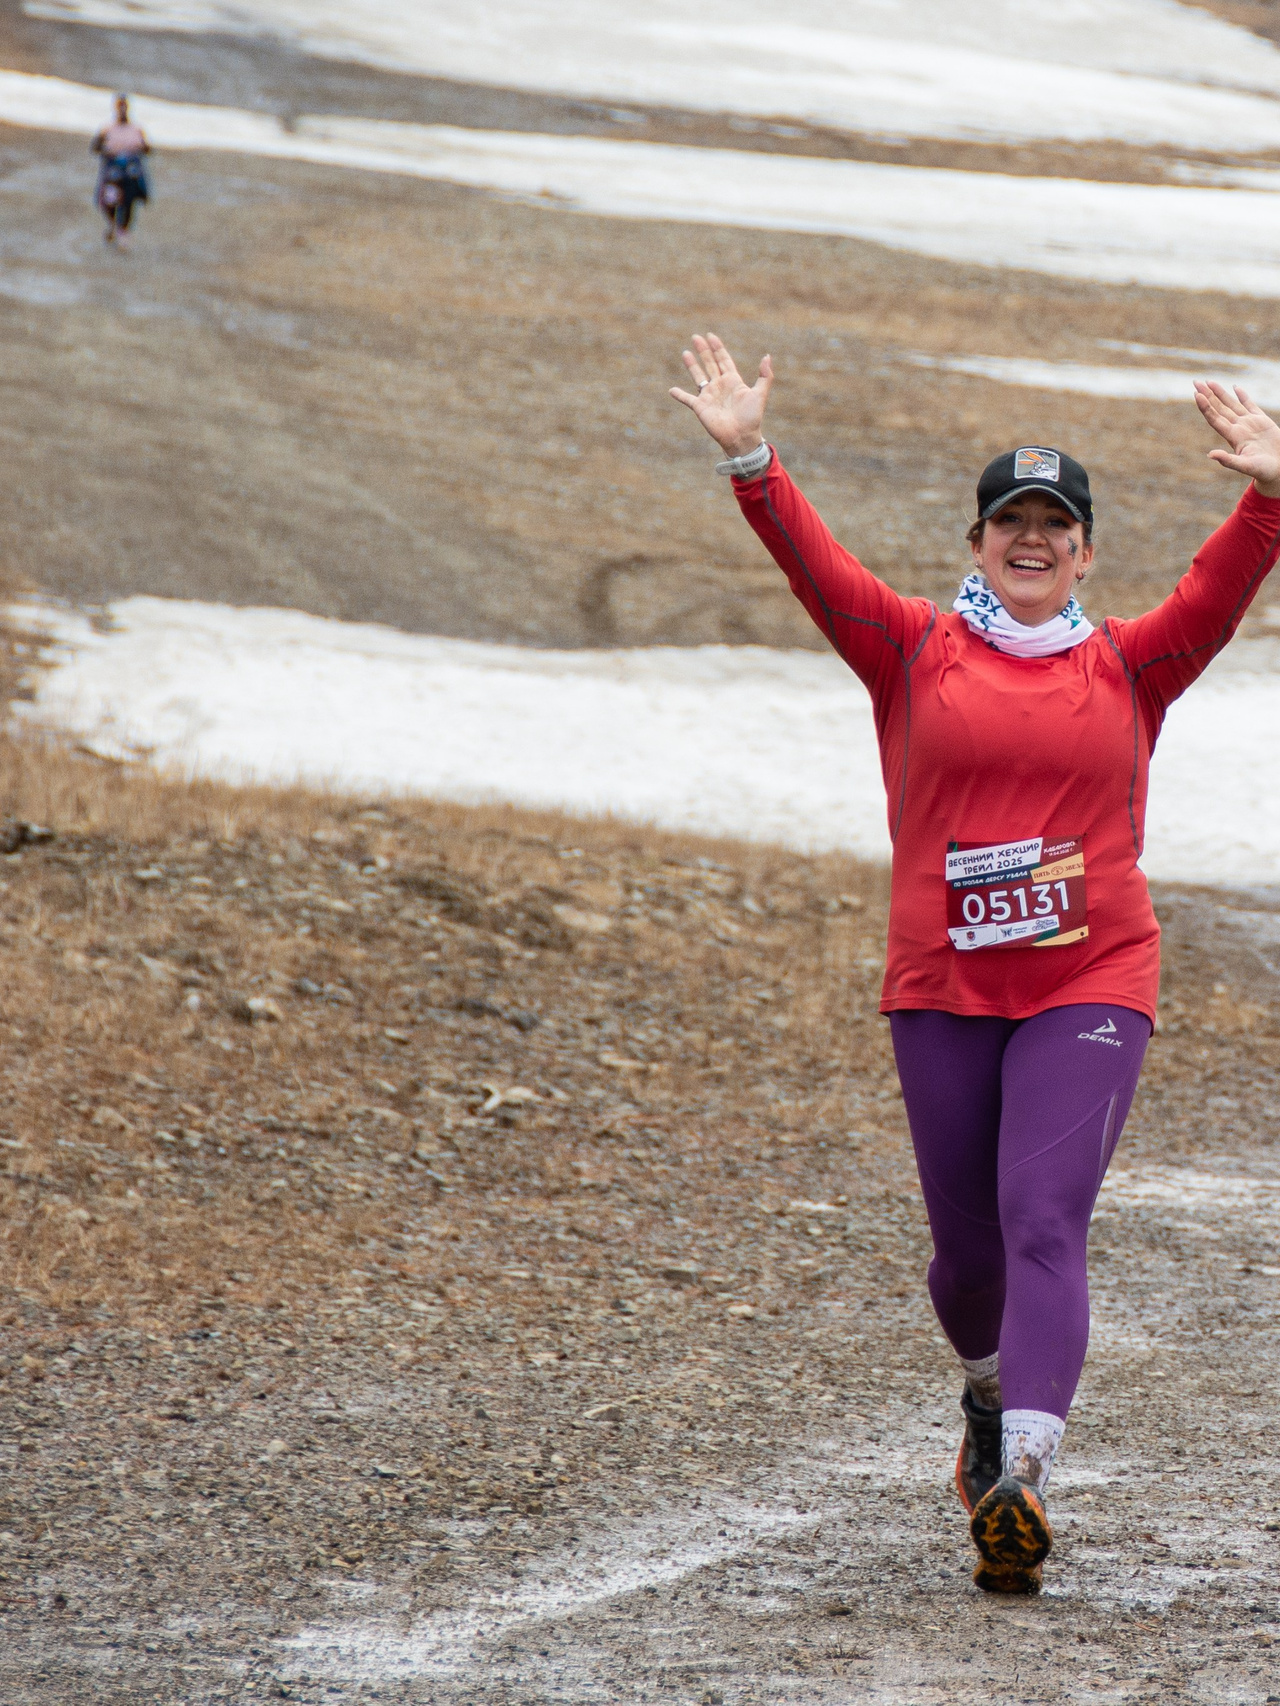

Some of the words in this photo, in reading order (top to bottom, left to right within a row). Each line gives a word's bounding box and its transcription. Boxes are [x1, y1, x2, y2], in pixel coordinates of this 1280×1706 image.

[948, 852, 993, 867] ВЕСЕННИЙ
[997, 843, 1040, 858] ХЕХЦИР
[964, 861, 993, 875] ТРЕЙЛ
[997, 857, 1023, 869] 2025
[1033, 870, 1051, 879] ПЯТЬ
[962, 880, 1069, 924] 05131
[1077, 1032, 1124, 1048] DEMIX
